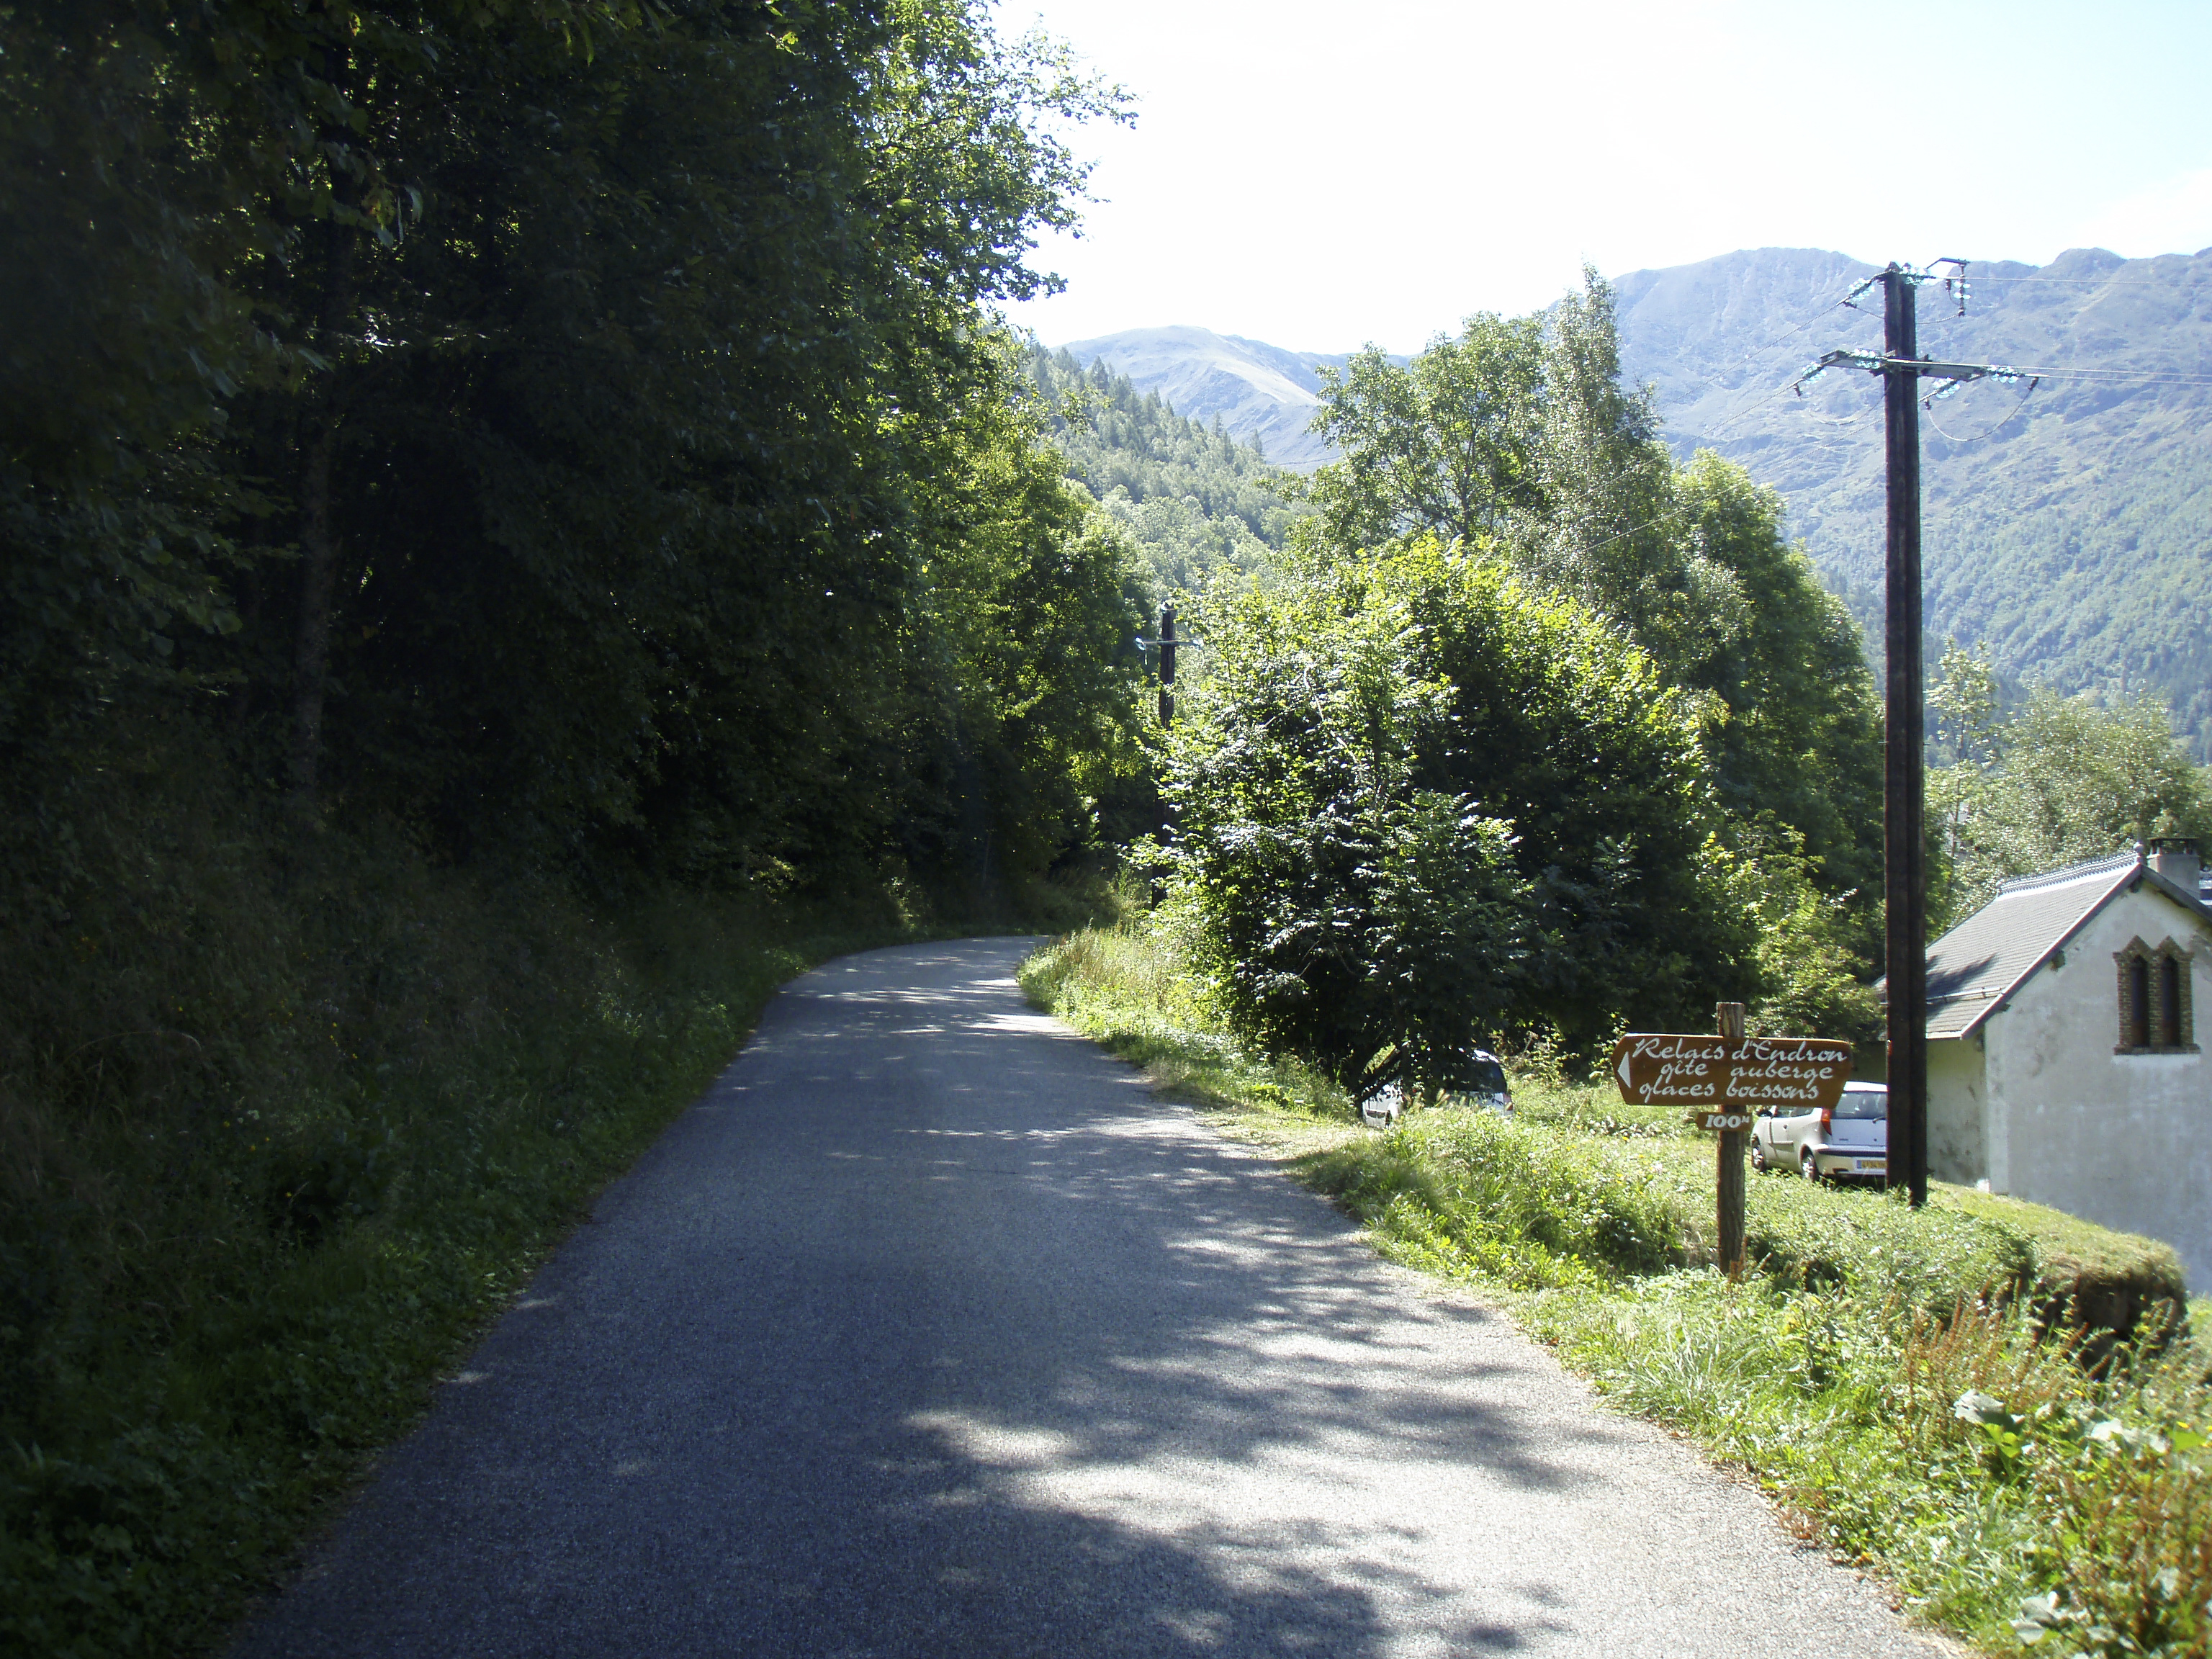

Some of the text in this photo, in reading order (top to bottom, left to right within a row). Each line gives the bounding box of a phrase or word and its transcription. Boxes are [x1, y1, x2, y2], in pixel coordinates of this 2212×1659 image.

[1632, 1038, 1847, 1062] Relais d'Endron
[1660, 1059, 1834, 1087] gîte auberge
[1639, 1075, 1820, 1103] glaces boissons
